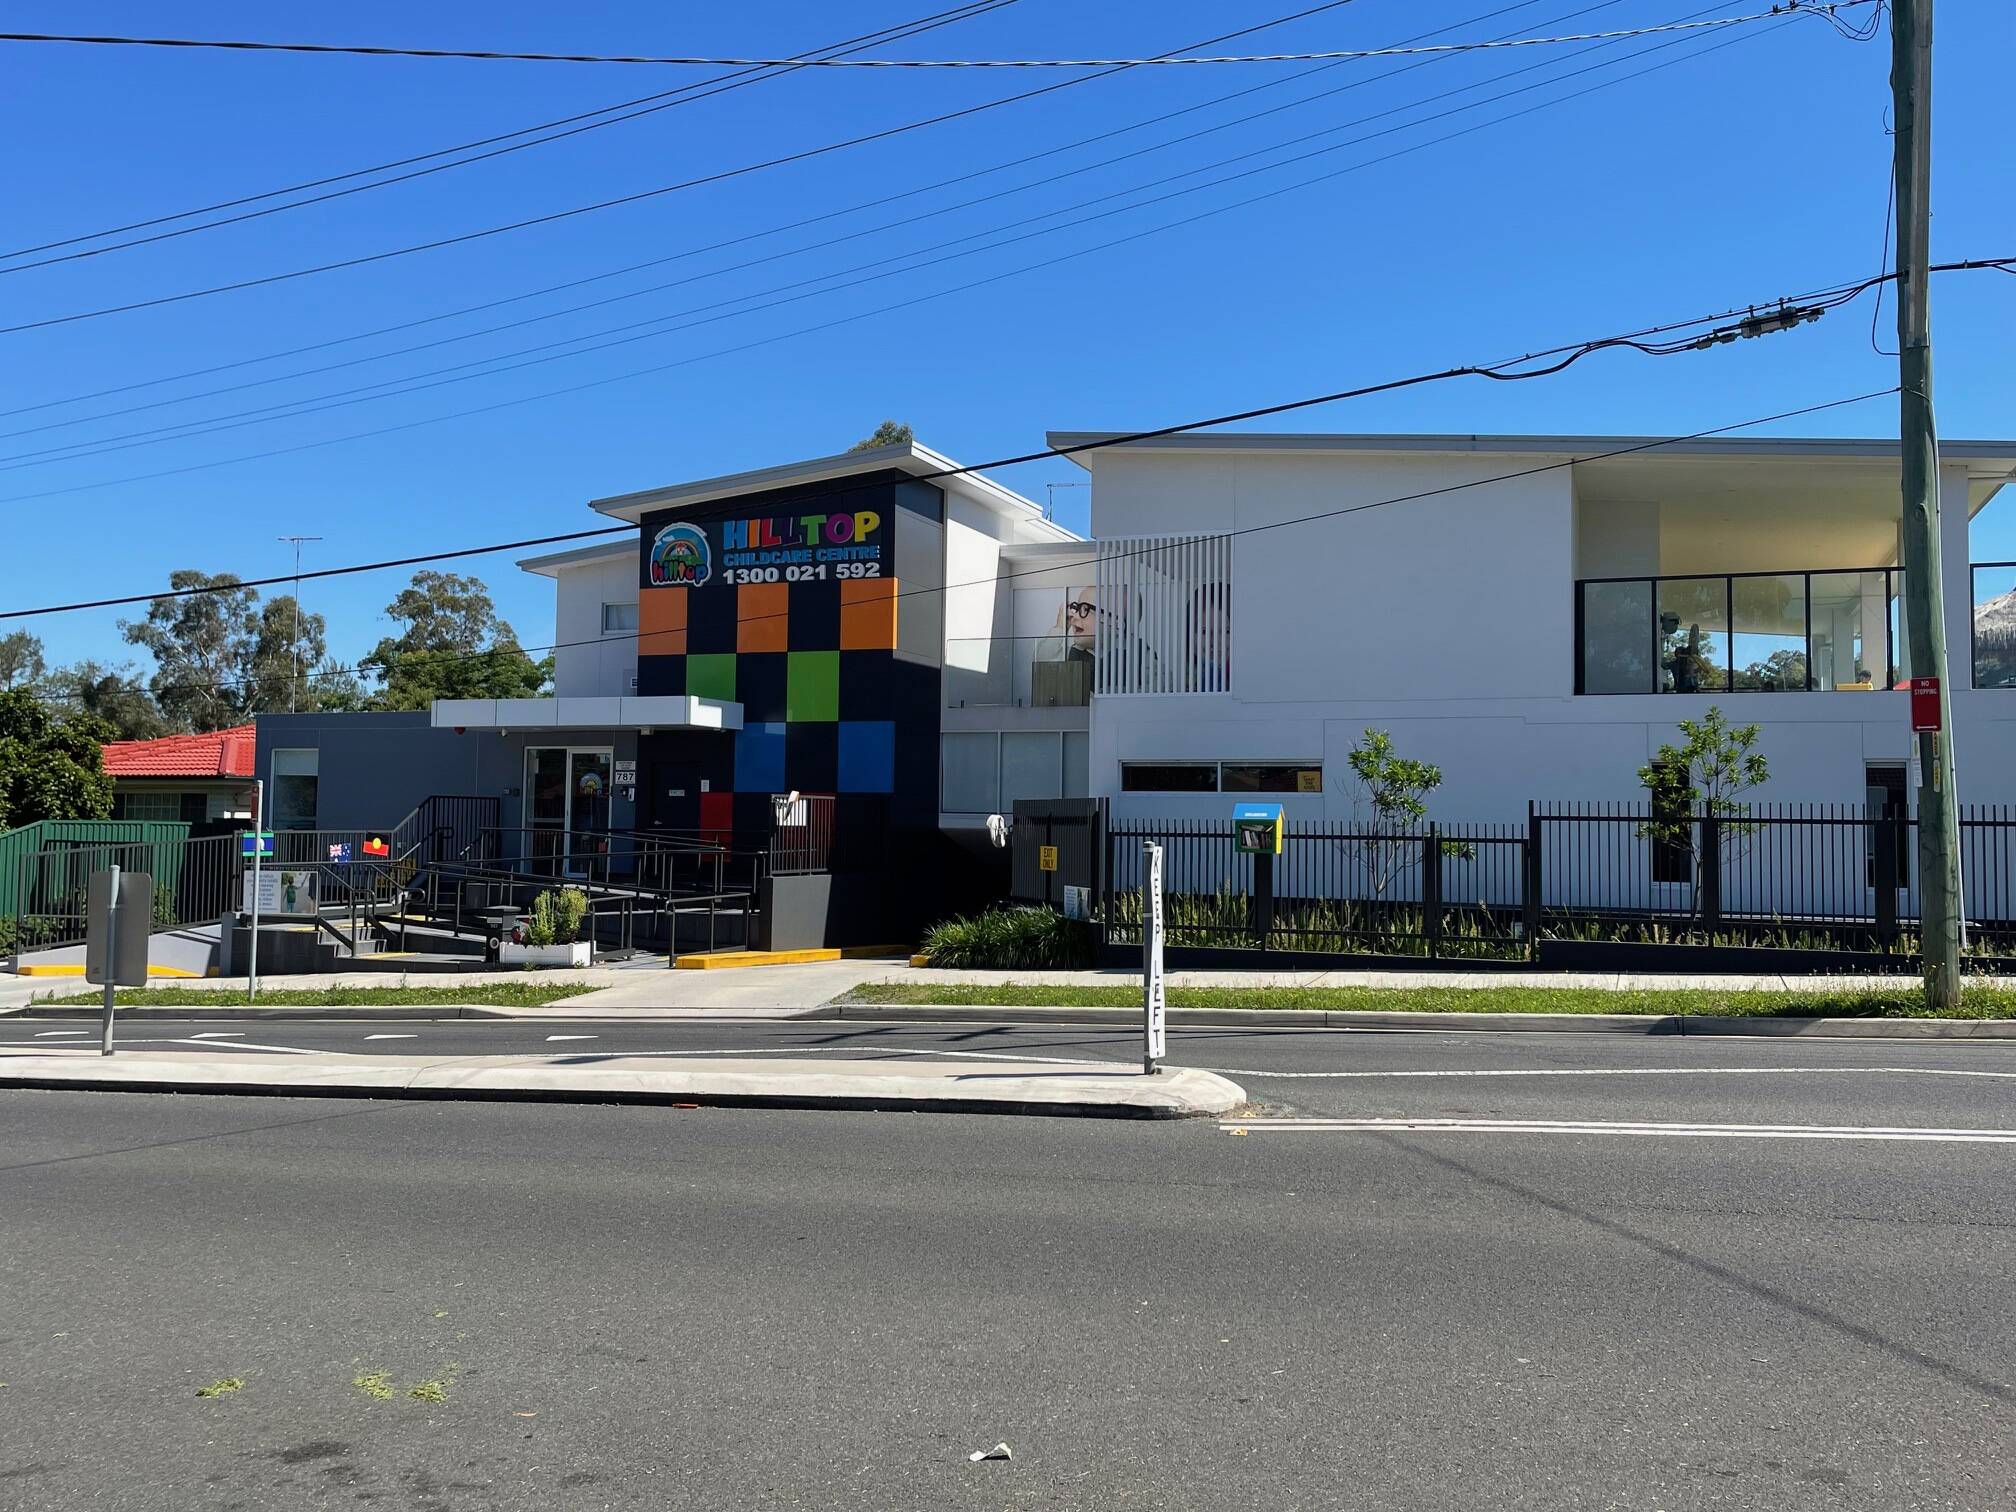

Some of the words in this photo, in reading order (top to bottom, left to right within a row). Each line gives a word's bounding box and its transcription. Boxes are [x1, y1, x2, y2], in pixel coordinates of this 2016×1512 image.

[723, 511, 880, 549] HILLTOP
[723, 549, 812, 567] CHILDCARE
[816, 544, 880, 561] CENTRE
[723, 567, 779, 584] 1300
[785, 564, 827, 582] 021
[835, 562, 880, 579] 592
[1914, 688, 1937, 696] STOPPING
[617, 773, 634, 781] 787
[1043, 848, 1053, 858] EXIT
[1042, 858, 1054, 869] ONLY
[1153, 959, 1161, 1049] LEFT
